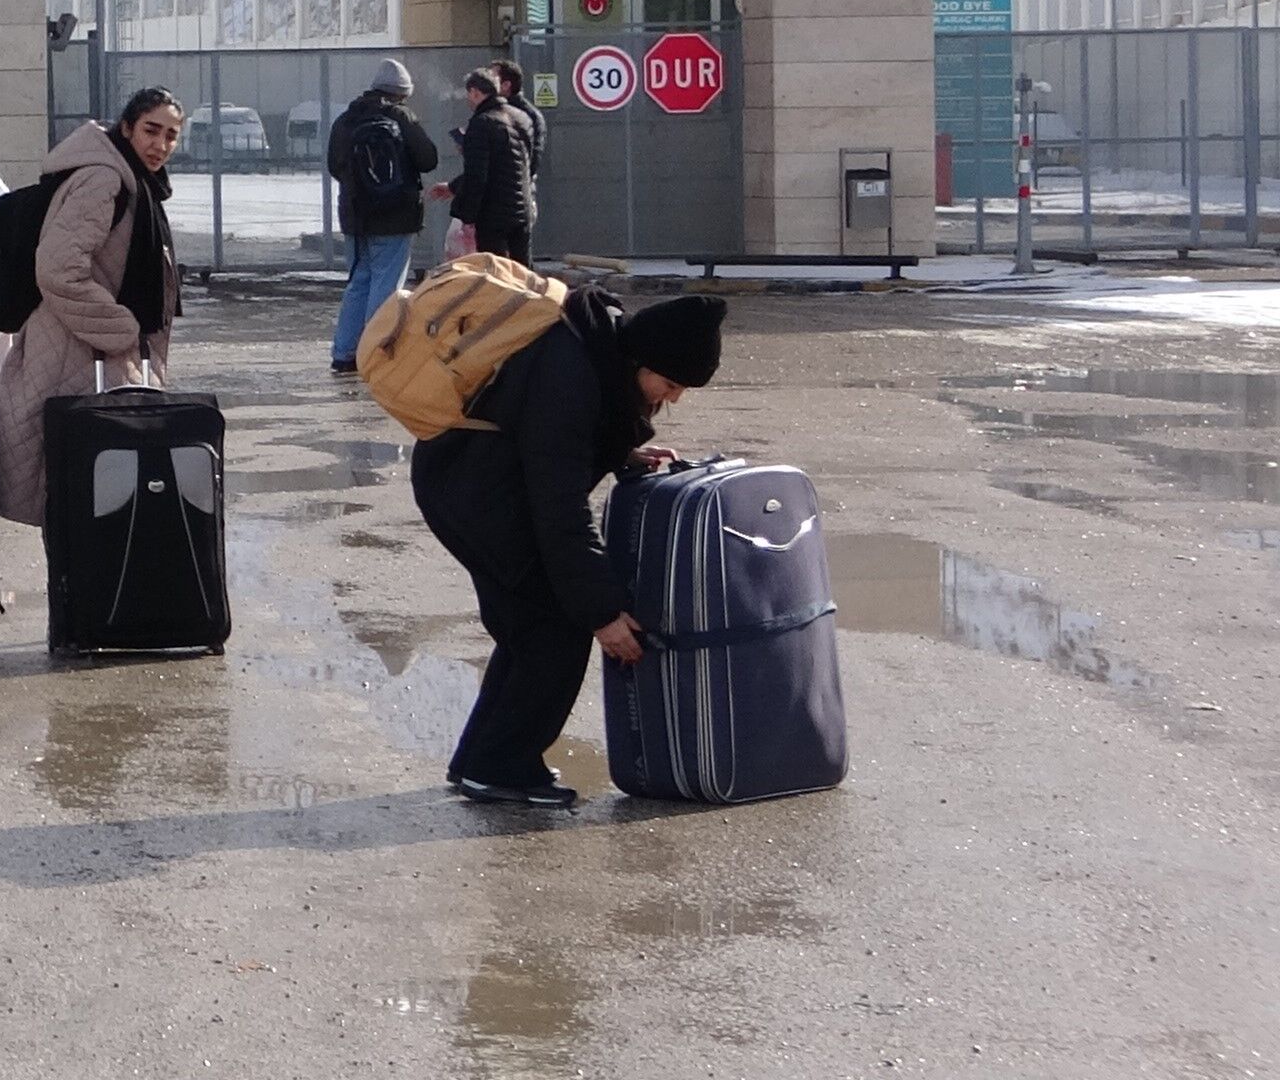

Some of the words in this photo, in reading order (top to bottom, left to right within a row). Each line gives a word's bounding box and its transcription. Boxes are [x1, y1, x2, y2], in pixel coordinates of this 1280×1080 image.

[963, 0, 992, 11] BYE
[588, 68, 622, 90] 30
[650, 57, 716, 90] DUR
